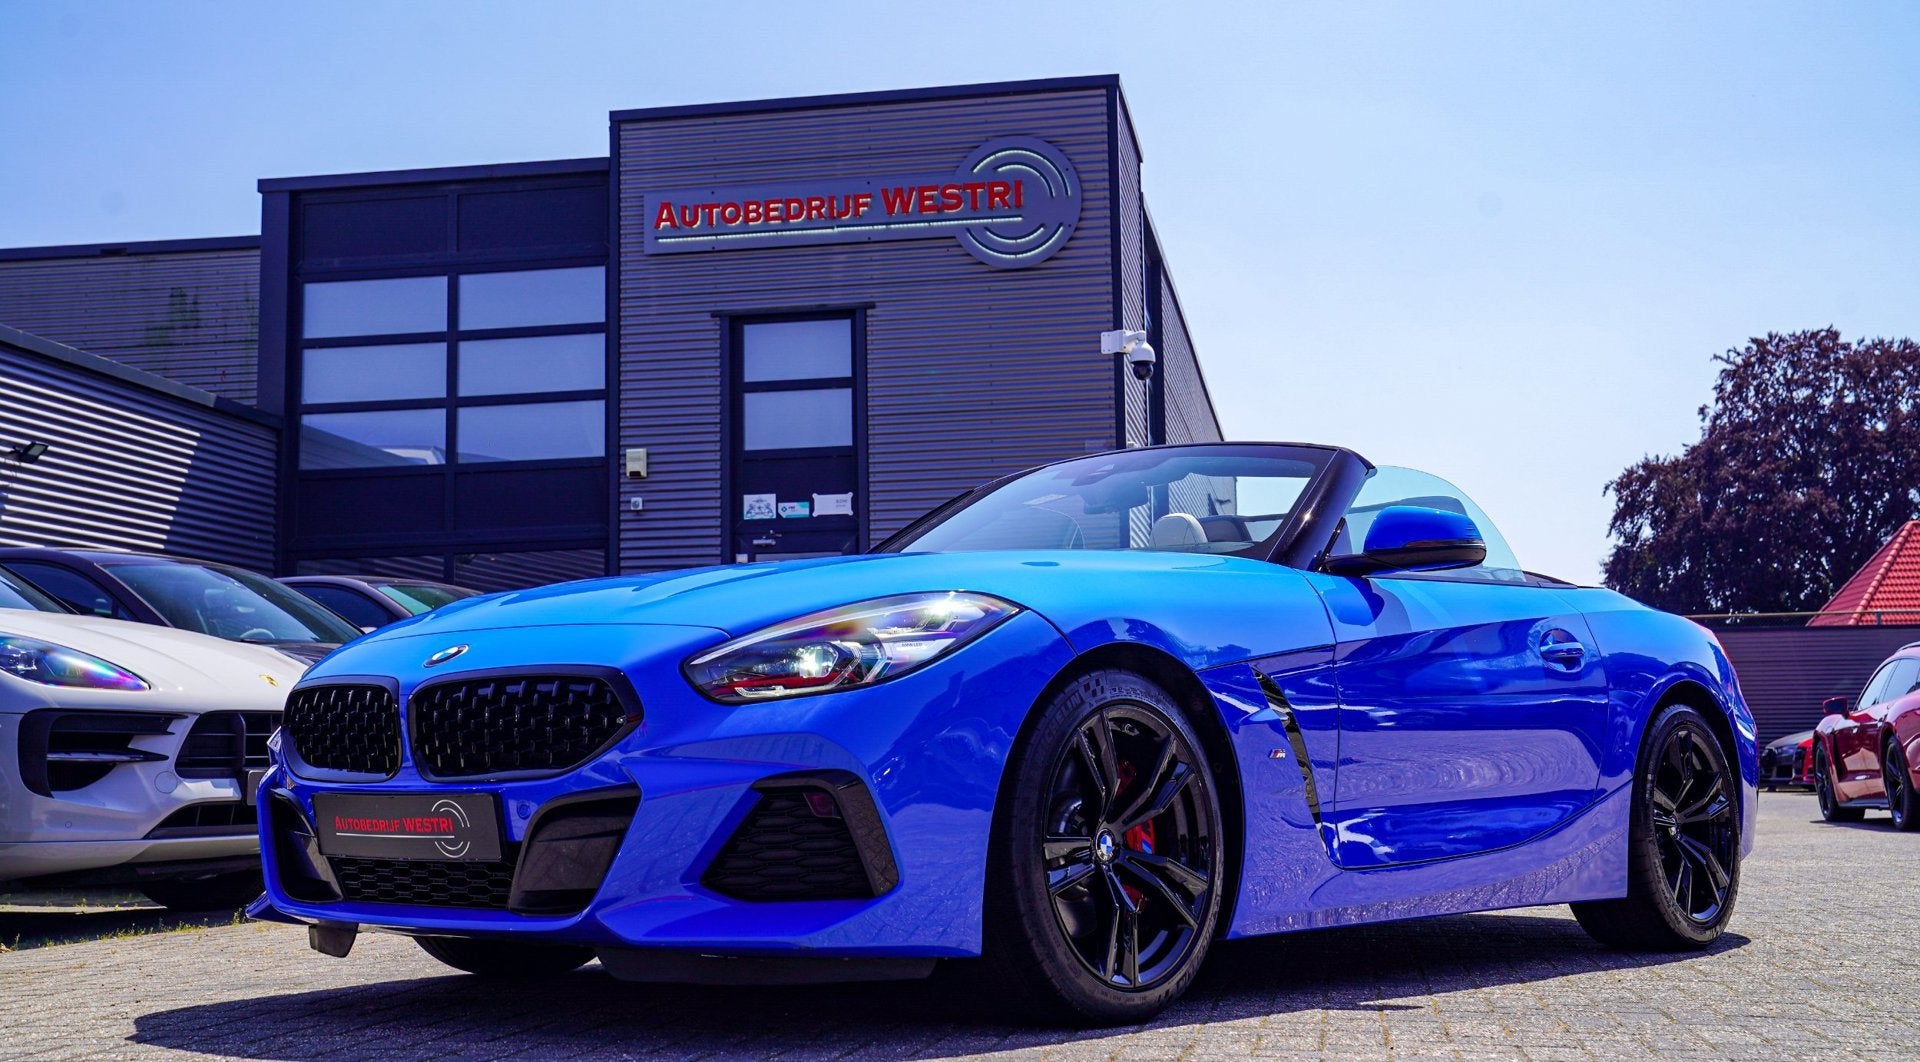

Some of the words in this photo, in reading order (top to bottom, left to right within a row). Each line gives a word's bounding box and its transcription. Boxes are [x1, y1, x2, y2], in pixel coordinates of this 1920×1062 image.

[654, 193, 872, 229] AUTOBEDRIJF
[880, 178, 1024, 215] WESTRI
[334, 816, 400, 832] AUTOBEDRIJF
[402, 817, 454, 833] WESTRI
